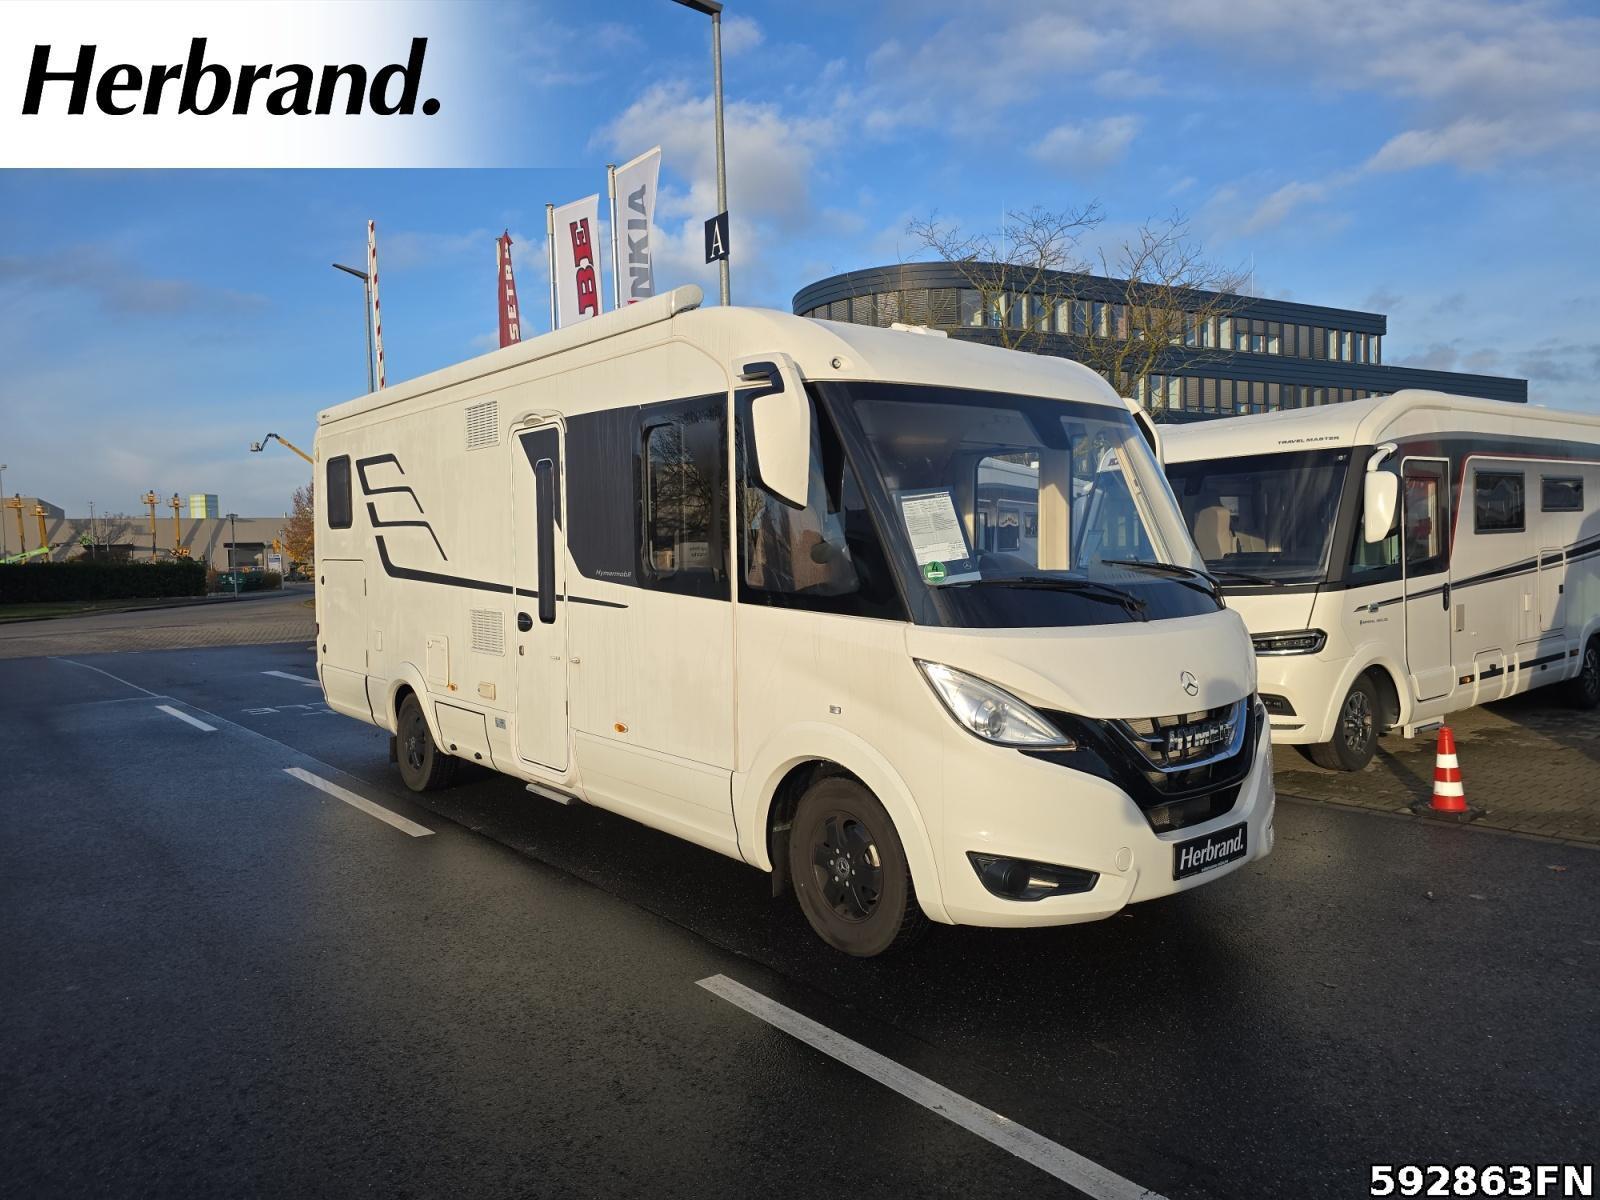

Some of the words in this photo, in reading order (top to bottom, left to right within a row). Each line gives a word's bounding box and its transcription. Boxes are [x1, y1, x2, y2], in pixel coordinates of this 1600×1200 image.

[627, 184, 656, 304] NKIA
[710, 219, 725, 259] A
[504, 242, 519, 341] SETRA
[931, 562, 939, 572] 4
[1180, 828, 1244, 870] Herbrand.
